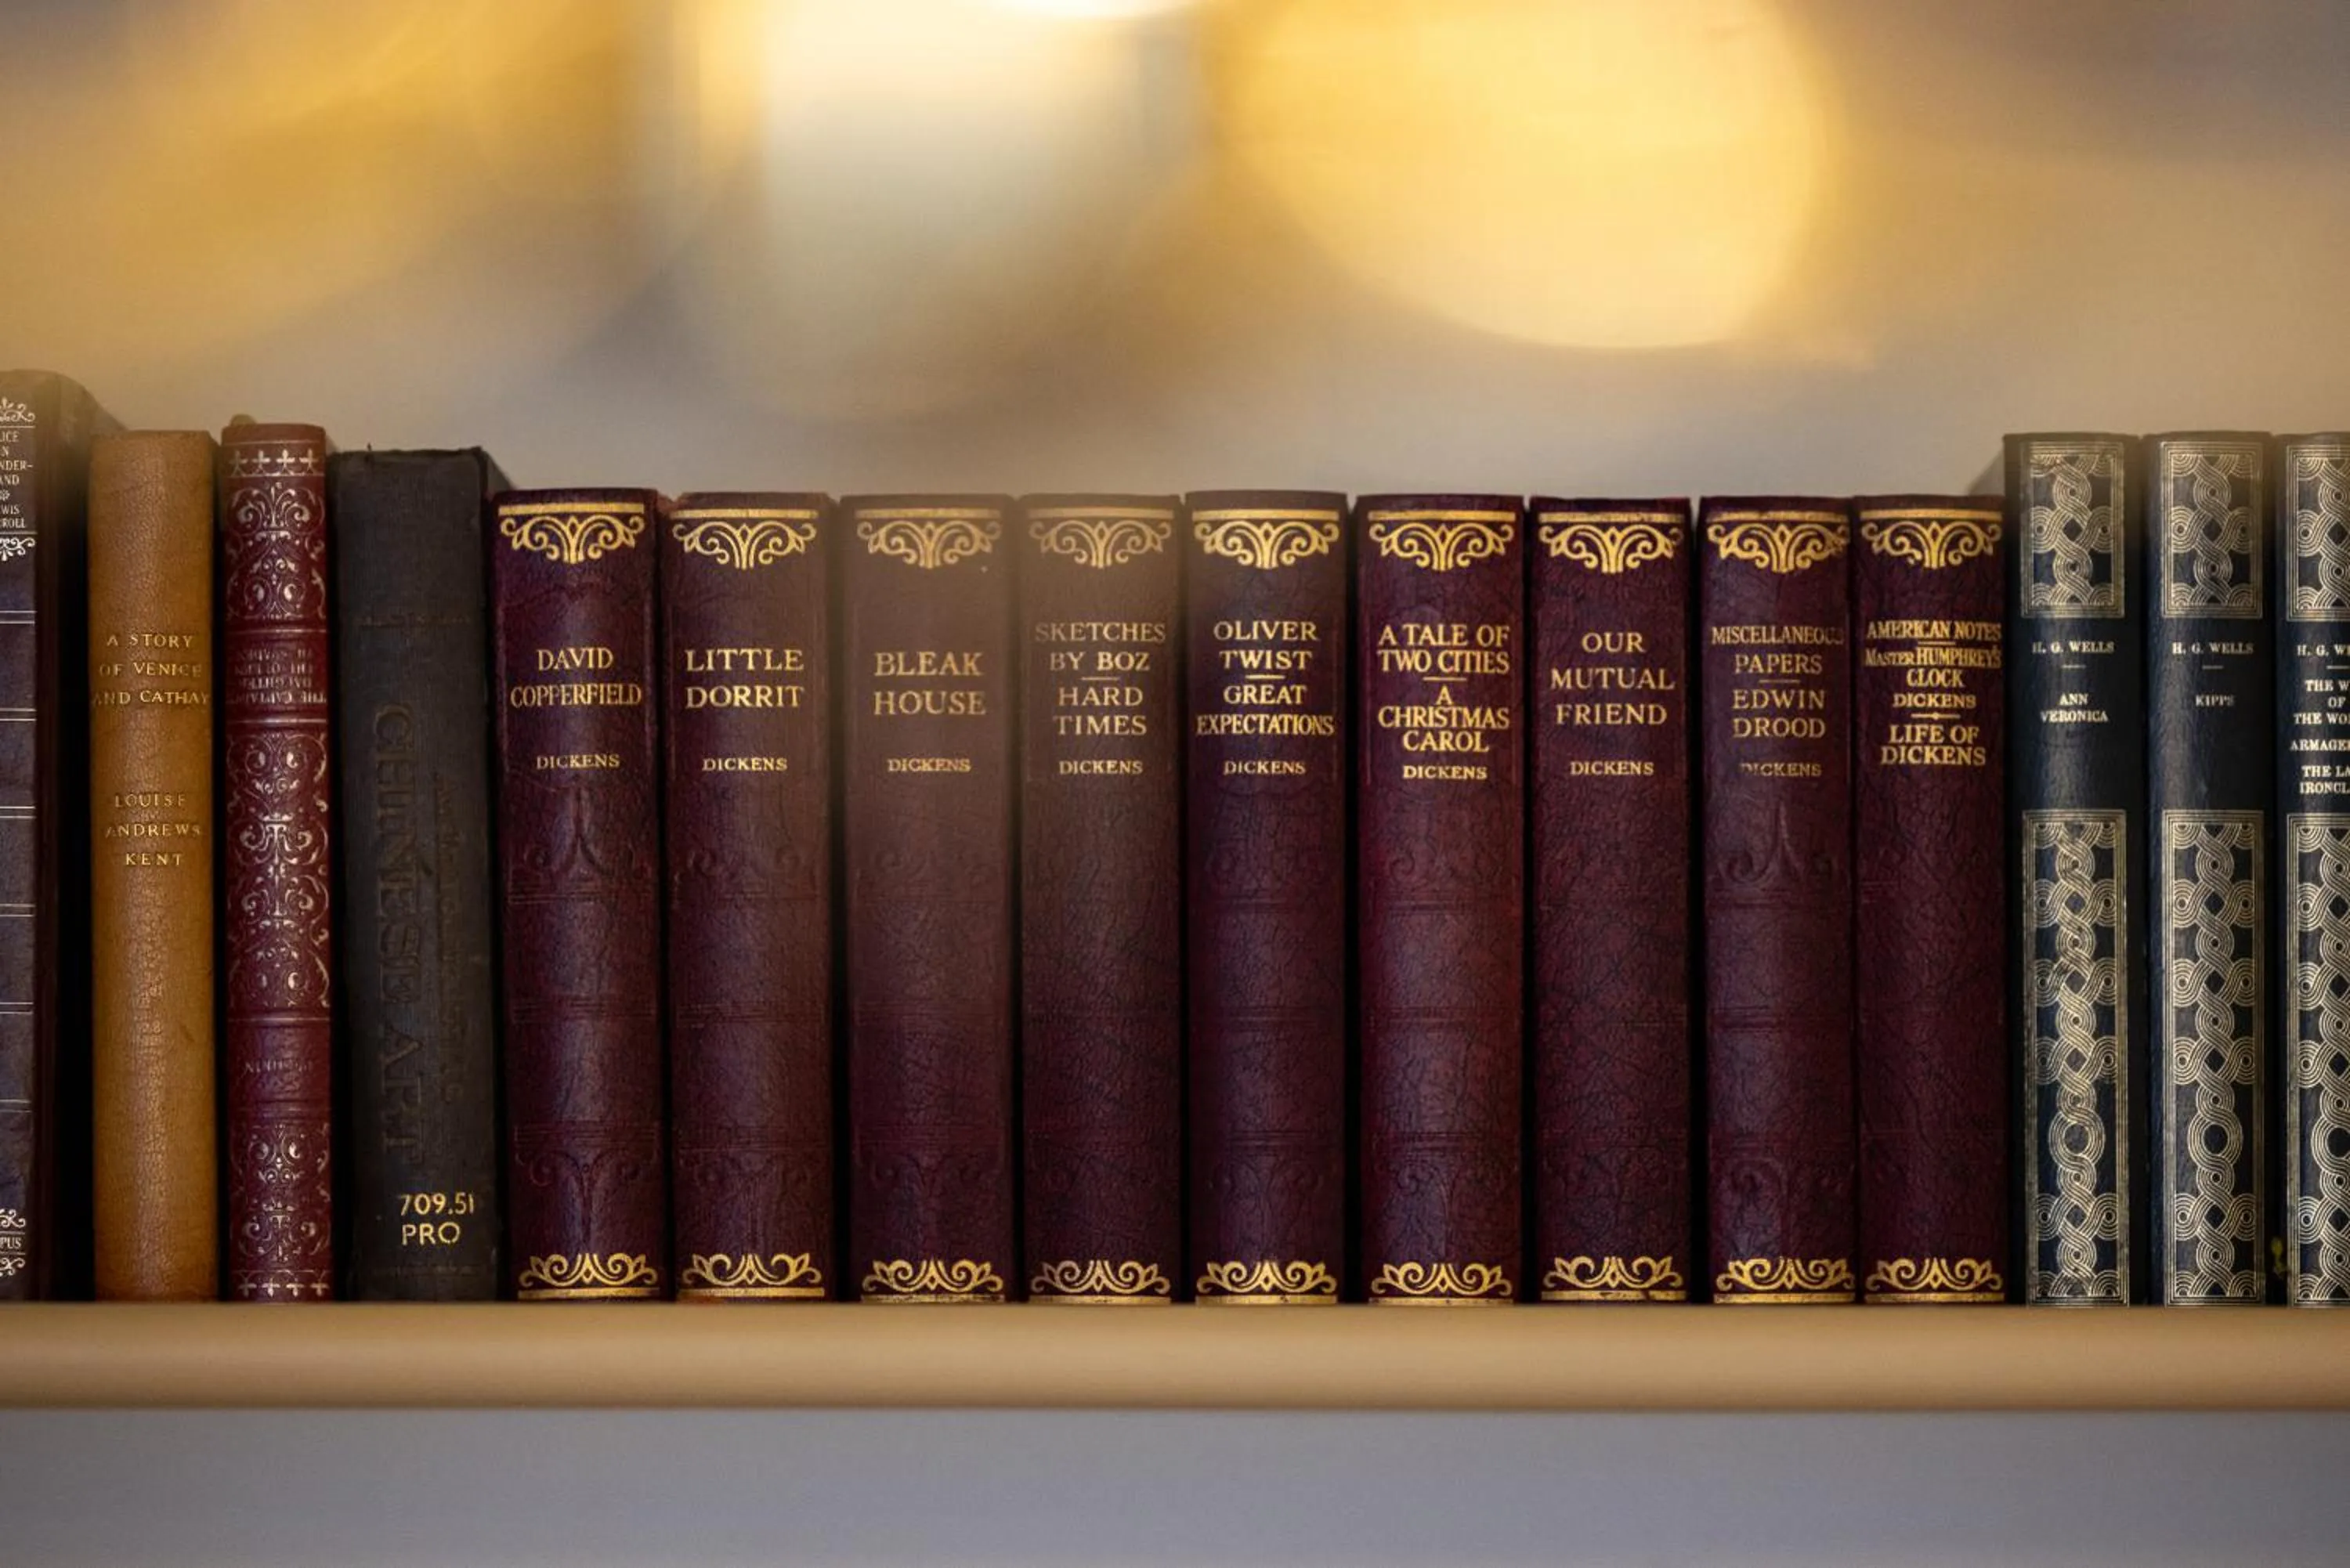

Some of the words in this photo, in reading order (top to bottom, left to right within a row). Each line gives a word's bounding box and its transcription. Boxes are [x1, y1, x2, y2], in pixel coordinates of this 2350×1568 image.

[1036, 622, 1166, 642] SKETCHES
[1213, 621, 1318, 641] OLIVER
[1378, 625, 1397, 646] A
[1402, 625, 1467, 647] TALE
[1476, 626, 1510, 648] OF
[1712, 625, 1844, 645] MISCELLANEOUS
[1867, 620, 1951, 639] AMERICAN
[1954, 623, 2002, 641] NOTES
[107, 634, 118, 647] A
[129, 634, 193, 649] STORY
[1582, 631, 1644, 653] OUR
[2051, 641, 2064, 654] G.
[2069, 641, 2115, 653] WELLS
[2172, 641, 2186, 655] H.
[2191, 641, 2204, 655] G.
[2209, 641, 2254, 655] WELLS
[2297, 645, 2311, 656] H.
[2316, 645, 2330, 657] G.
[537, 647, 614, 671] DAVID
[685, 649, 804, 672] LITTLE
[874, 652, 984, 677] BLEAK
[1050, 652, 1086, 671] BY
[1097, 652, 1151, 671] BOZ
[1219, 650, 1312, 670] TWIST
[1377, 649, 1431, 673] TWO
[1438, 650, 1510, 674] CITIES
[1735, 653, 1823, 674] PAPERS
[99, 663, 122, 676] OF
[133, 662, 202, 677] VENICE
[1551, 667, 1675, 690] MUTUAL
[1906, 668, 1965, 688] CLOCK
[511, 683, 642, 707] COPPERFIELD
[1224, 685, 1307, 705] GREAT
[1435, 685, 1453, 705] A
[2305, 679, 2334, 692] THE
[93, 692, 132, 705] AND
[140, 689, 210, 705] CATHAY
[685, 685, 804, 709] DORRIT
[873, 691, 986, 716] HOUSE
[1059, 686, 1144, 707] HARD
[1732, 689, 1826, 710] EDWIN
[1893, 693, 1976, 709] DICKENS
[2059, 692, 2088, 706] ANN
[2328, 697, 2347, 709] OF
[1197, 714, 1335, 735] EXPECTATIONS
[1378, 706, 1510, 729] CHRISTMAS
[1556, 704, 1668, 725] FRIEND
[2040, 710, 2109, 723] VERONICA
[2294, 712, 2322, 724] THE
[2326, 712, 2350, 724] WO
[1054, 715, 1148, 736] TIMES
[1734, 717, 1826, 739] DROOD
[1889, 724, 1944, 743] LIFE
[1950, 726, 1980, 744] OF
[1403, 731, 1490, 753] CAROL
[2290, 739, 2350, 751] ARMAGE
[537, 753, 620, 770] DICKENS
[703, 757, 787, 771] DICKENS
[888, 758, 971, 773] DICKENS
[1880, 746, 1987, 766] DICKENS
[1058, 760, 1144, 775] DICKENS
[1224, 761, 1307, 775] DICKENS
[1403, 764, 1488, 780] DICKENS
[1571, 761, 1654, 775] DICKENS
[1740, 762, 1822, 777] DICKENS
[2301, 764, 2331, 778] THE
[2300, 782, 2350, 795] IRONCL
[114, 793, 186, 807] LOUISE
[105, 823, 201, 838] ANDREWS
[125, 853, 183, 865] KENT
[398, 1192, 474, 1216] 709.51
[402, 1222, 461, 1246] PRO
